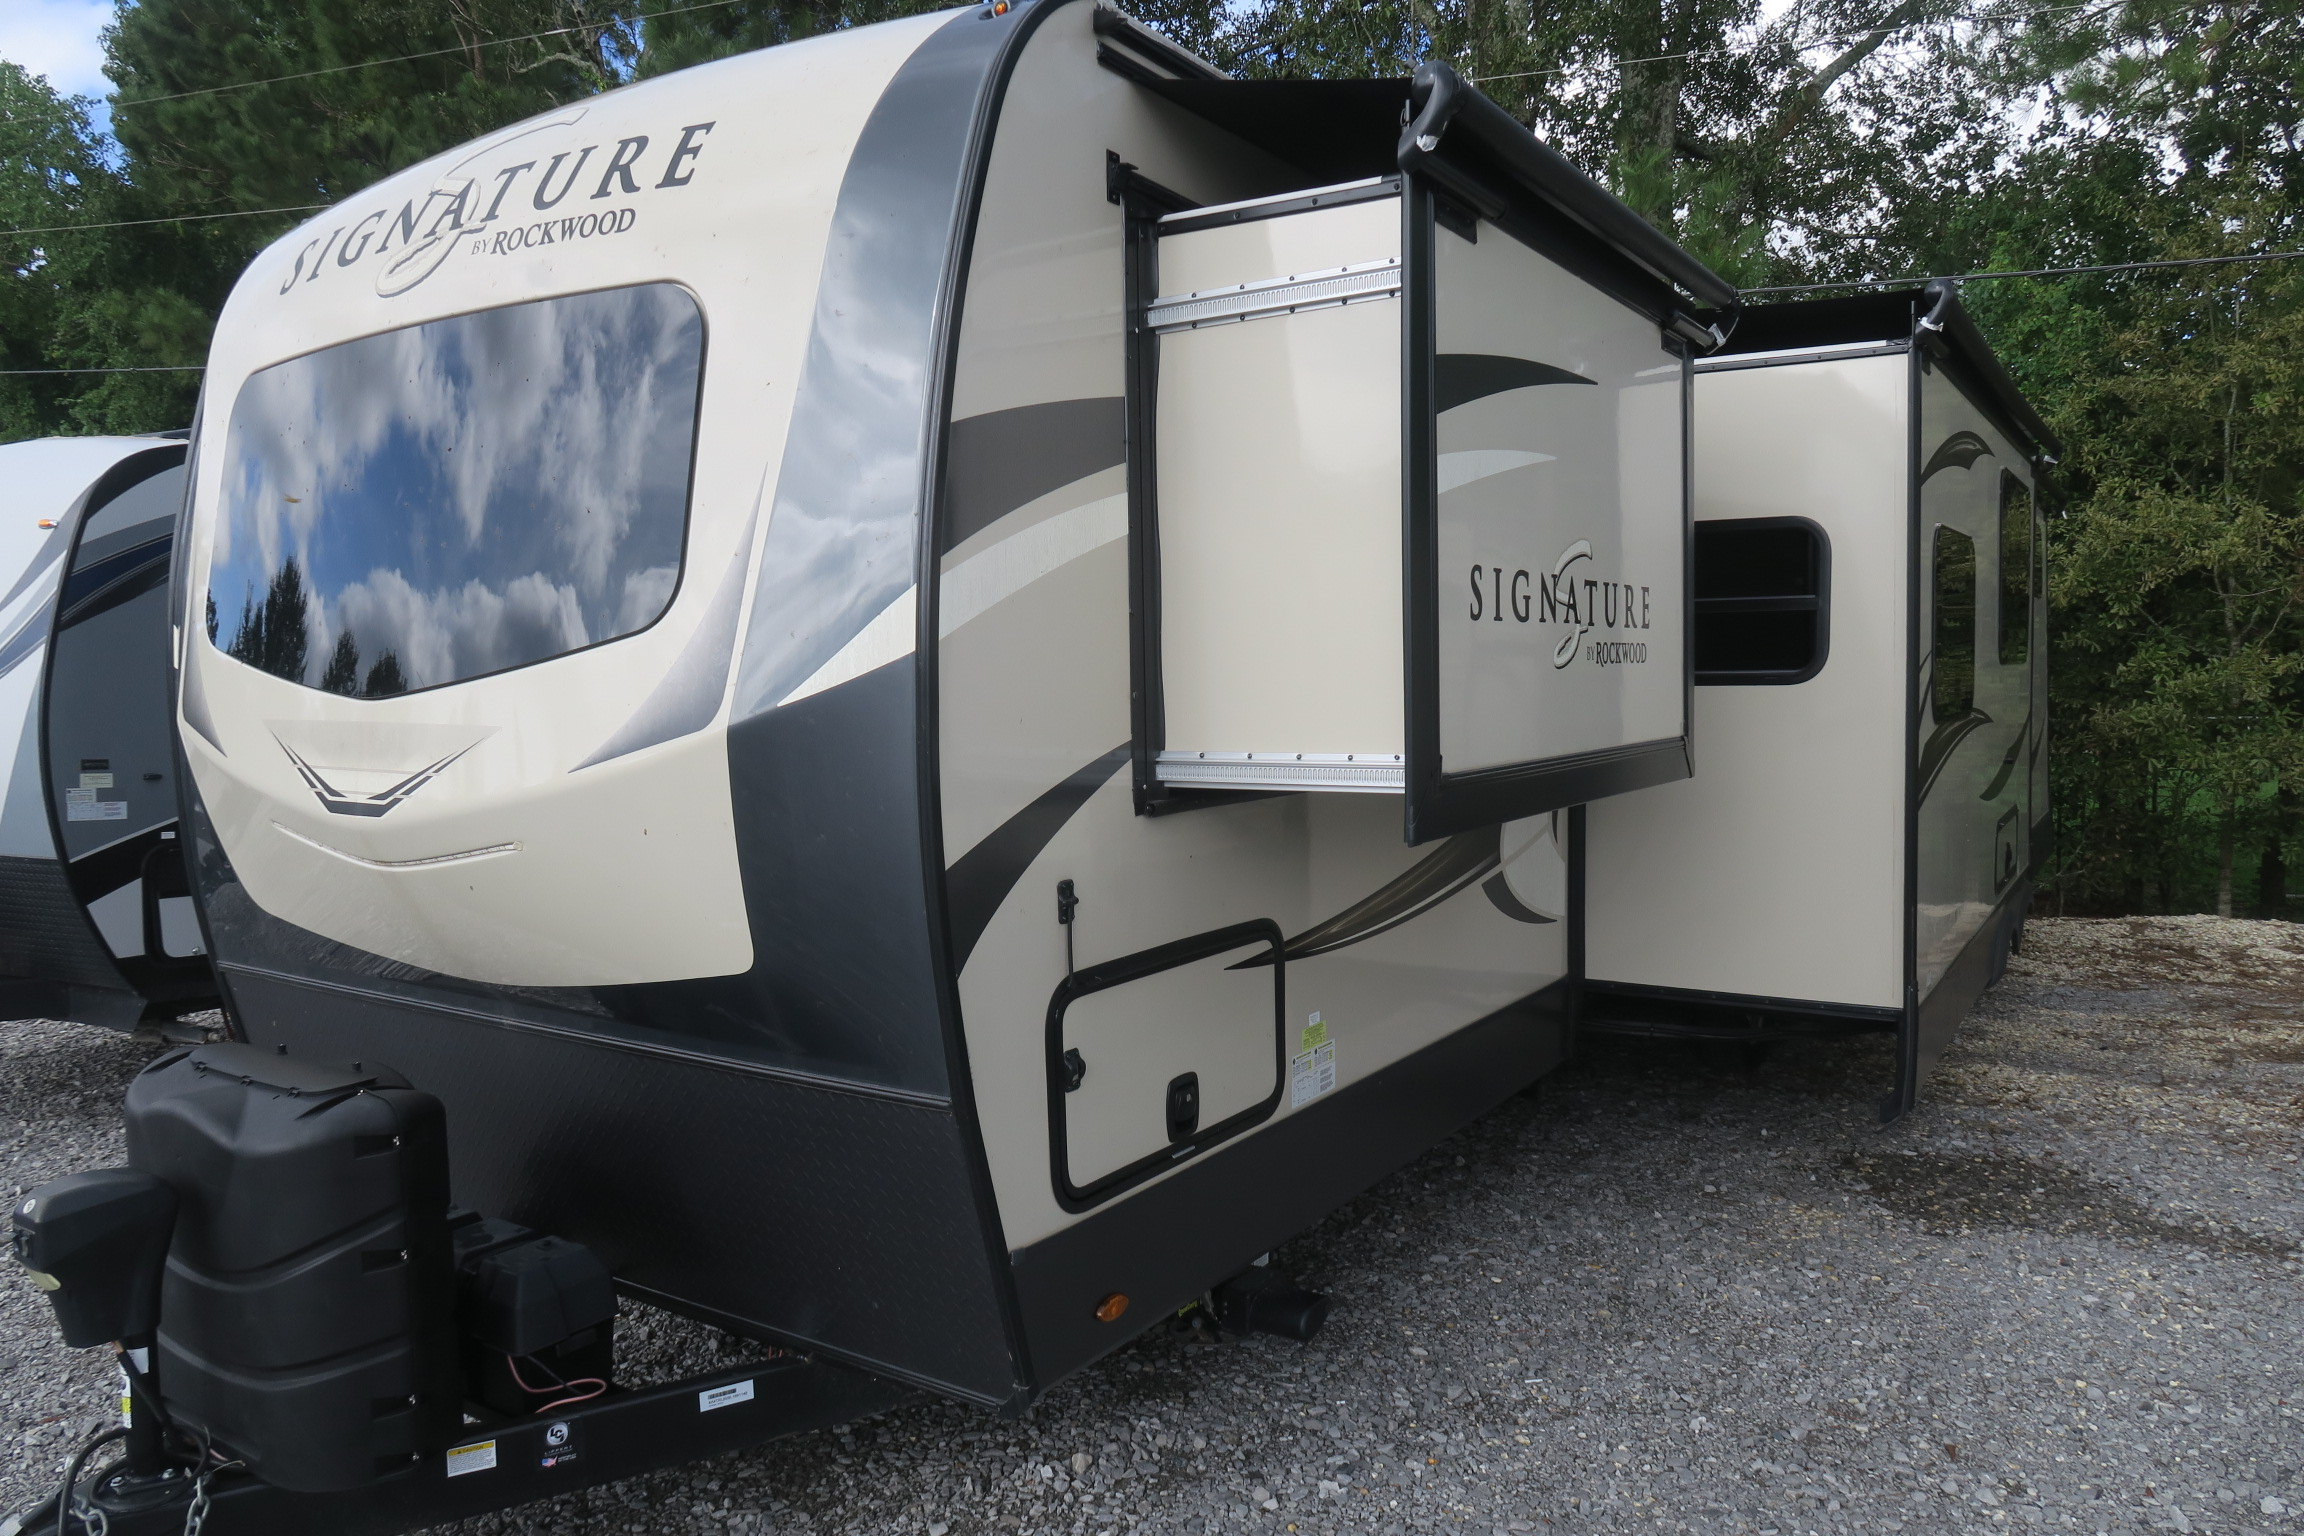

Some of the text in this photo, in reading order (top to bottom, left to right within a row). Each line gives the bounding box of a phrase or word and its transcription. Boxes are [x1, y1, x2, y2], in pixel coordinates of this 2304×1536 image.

[280, 121, 717, 296] SIGNATURE
[471, 208, 637, 256] BY ROCKWOOD
[1469, 564, 1650, 630] SIGNATURE
[1586, 641, 1648, 667] BY ROCKWOOD
